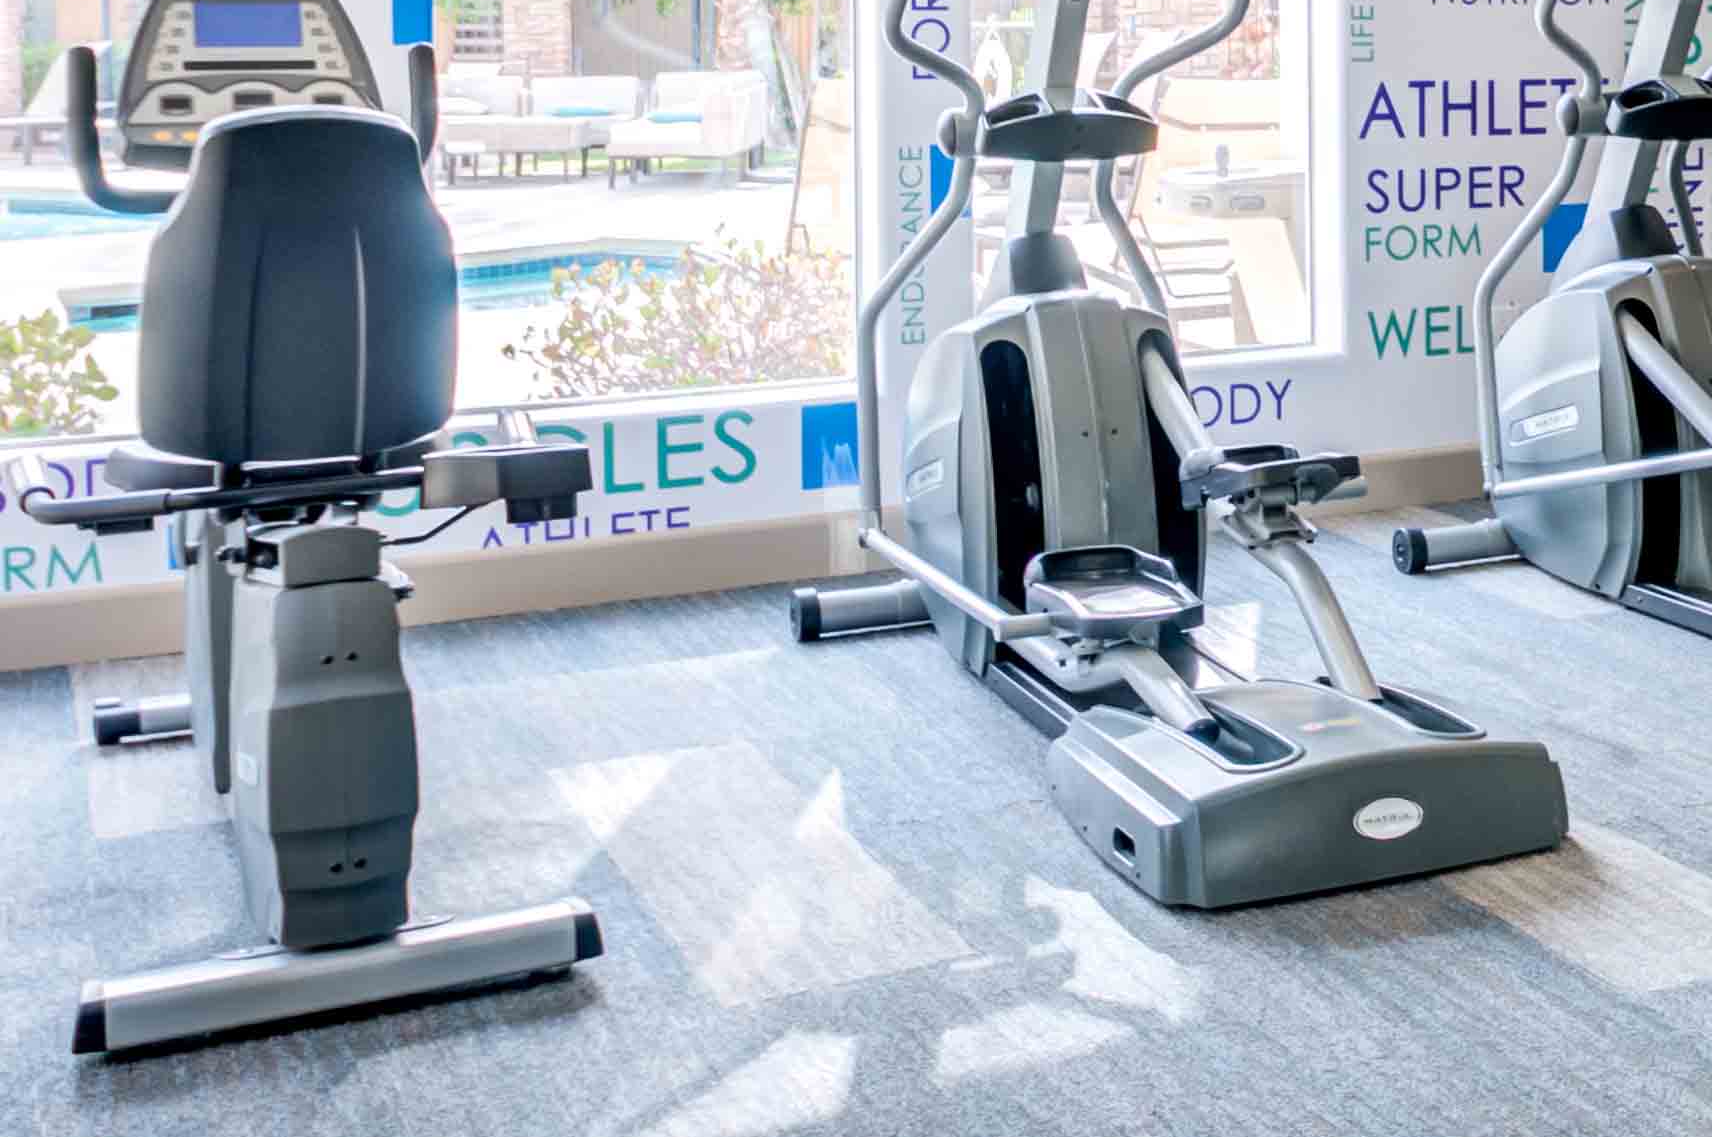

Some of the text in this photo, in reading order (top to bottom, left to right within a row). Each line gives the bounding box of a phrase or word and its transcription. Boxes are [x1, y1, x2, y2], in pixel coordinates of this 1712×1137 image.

[1351, 5, 1375, 63] LIFE
[1365, 165, 1525, 214] SUPER
[1364, 221, 1481, 263] FORM
[1190, 379, 1291, 428] ODY
